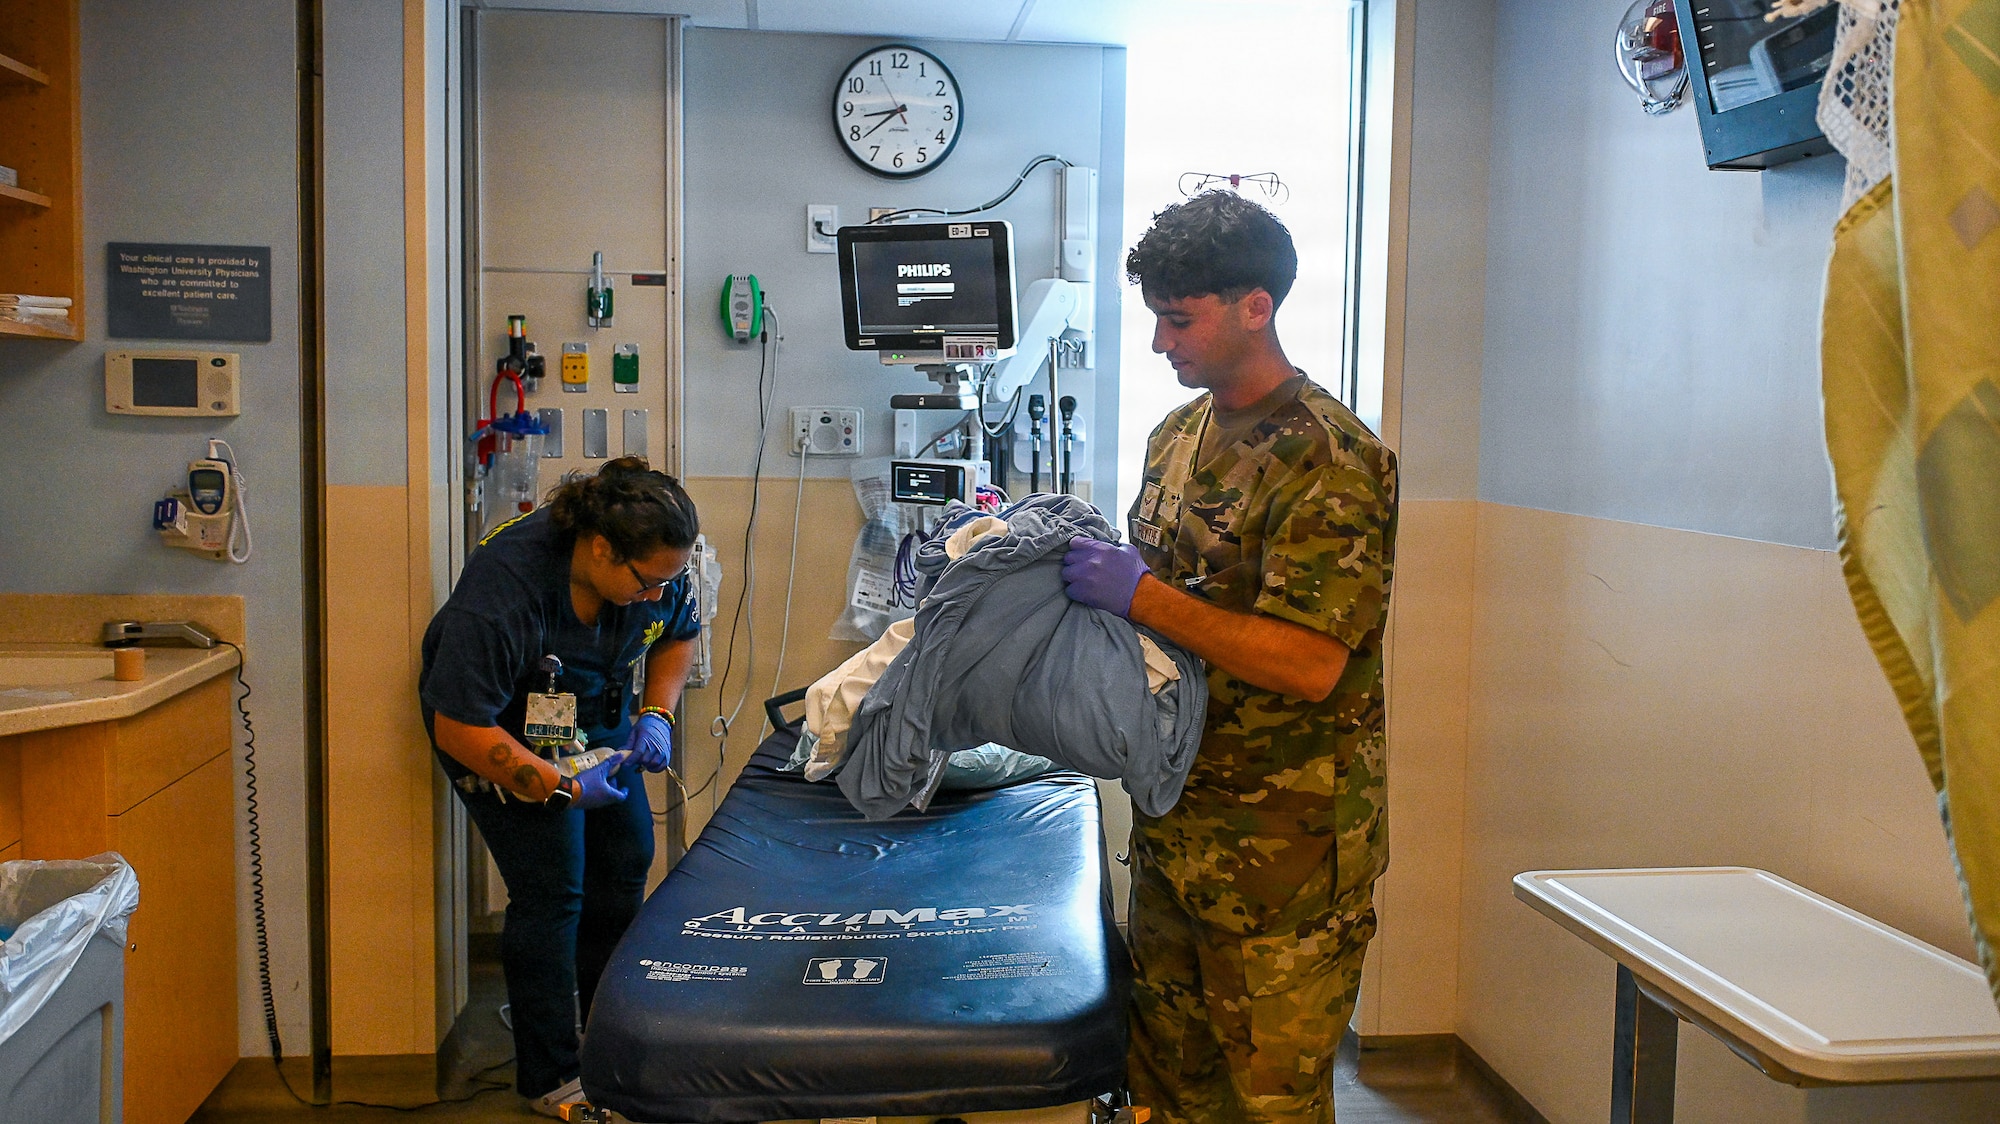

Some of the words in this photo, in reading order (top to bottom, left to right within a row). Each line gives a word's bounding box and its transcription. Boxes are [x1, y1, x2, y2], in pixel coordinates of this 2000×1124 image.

[1653, 3, 1667, 16] FIRE
[869, 60, 882, 76] 11
[891, 53, 909, 69] 12
[919, 62, 926, 78] 1
[848, 77, 864, 93] 10
[935, 80, 946, 96] 2
[843, 101, 854, 118] 9
[943, 105, 953, 121] 3
[850, 125, 861, 141] 8
[935, 129, 945, 145] 4
[869, 145, 880, 161] 7
[893, 152, 904, 168] 6
[916, 147, 927, 163] 5
[120, 253, 139, 262] Your
[143, 255, 172, 263] clinical
[198, 256, 205, 264] is
[208, 257, 245, 266] provided
[248, 258, 259, 267] by
[120, 265, 168, 275] Washington
[171, 267, 212, 277] University
[216, 269, 259, 278] Physicians
[898, 264, 951, 277] PHILIPS
[141, 277, 159, 286] who
[180, 279, 226, 288] committed
[142, 290, 180, 298] excellent
[183, 291, 213, 299] patient
[216, 292, 238, 300] care.
[547, 725, 564, 737] TECH
[681, 930, 763, 941] Pressure
[769, 933, 900, 941] Redistribution
[907, 926, 996, 938] Stretcher
[653, 961, 748, 973] encompass
